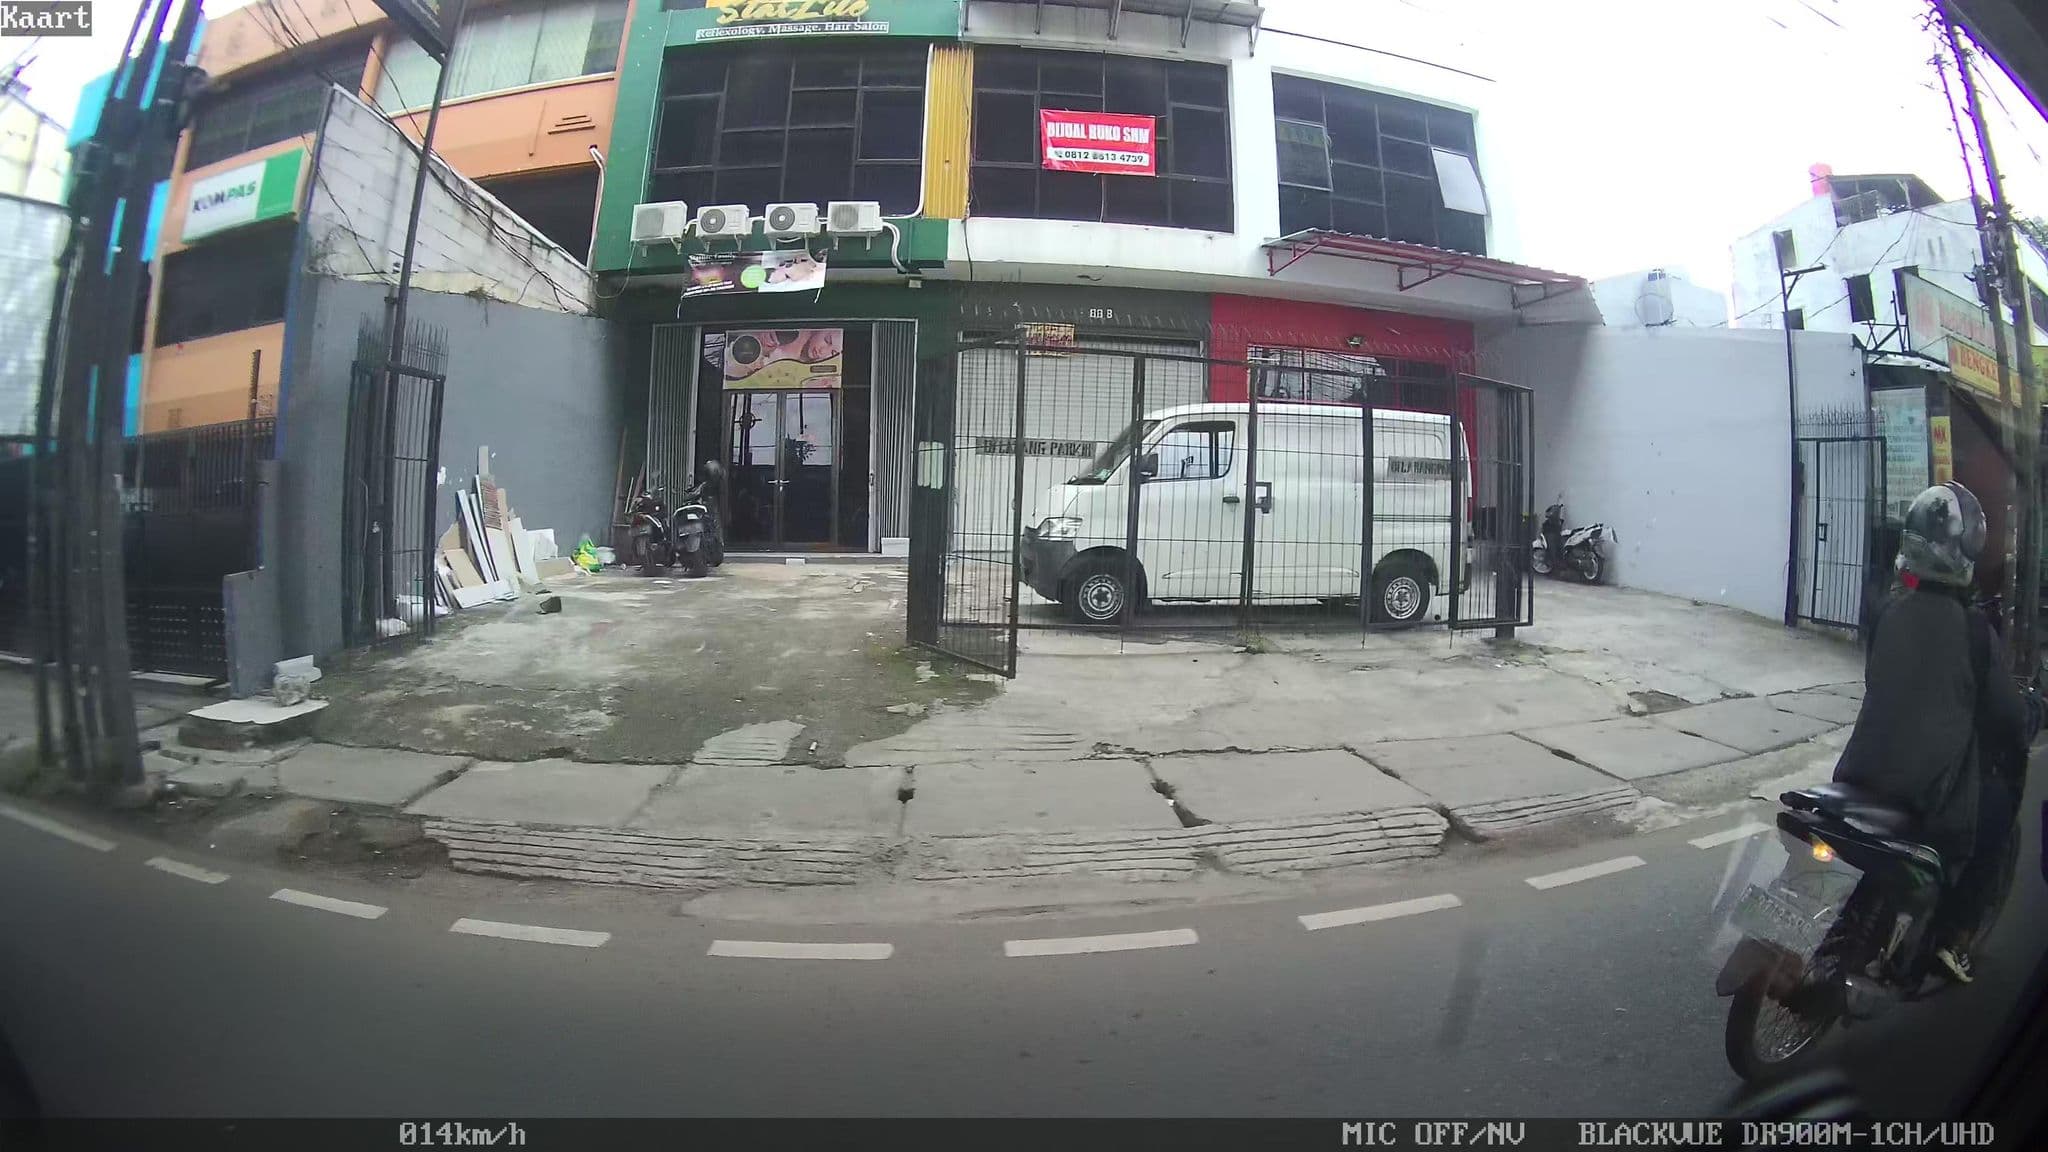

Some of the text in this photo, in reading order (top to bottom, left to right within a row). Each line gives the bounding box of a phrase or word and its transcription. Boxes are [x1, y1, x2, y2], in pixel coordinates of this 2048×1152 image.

[825, 22, 849, 31] Hair
[853, 21, 887, 31] Salon
[1064, 151, 1089, 159] 0812
[193, 181, 257, 213] KOMPAS
